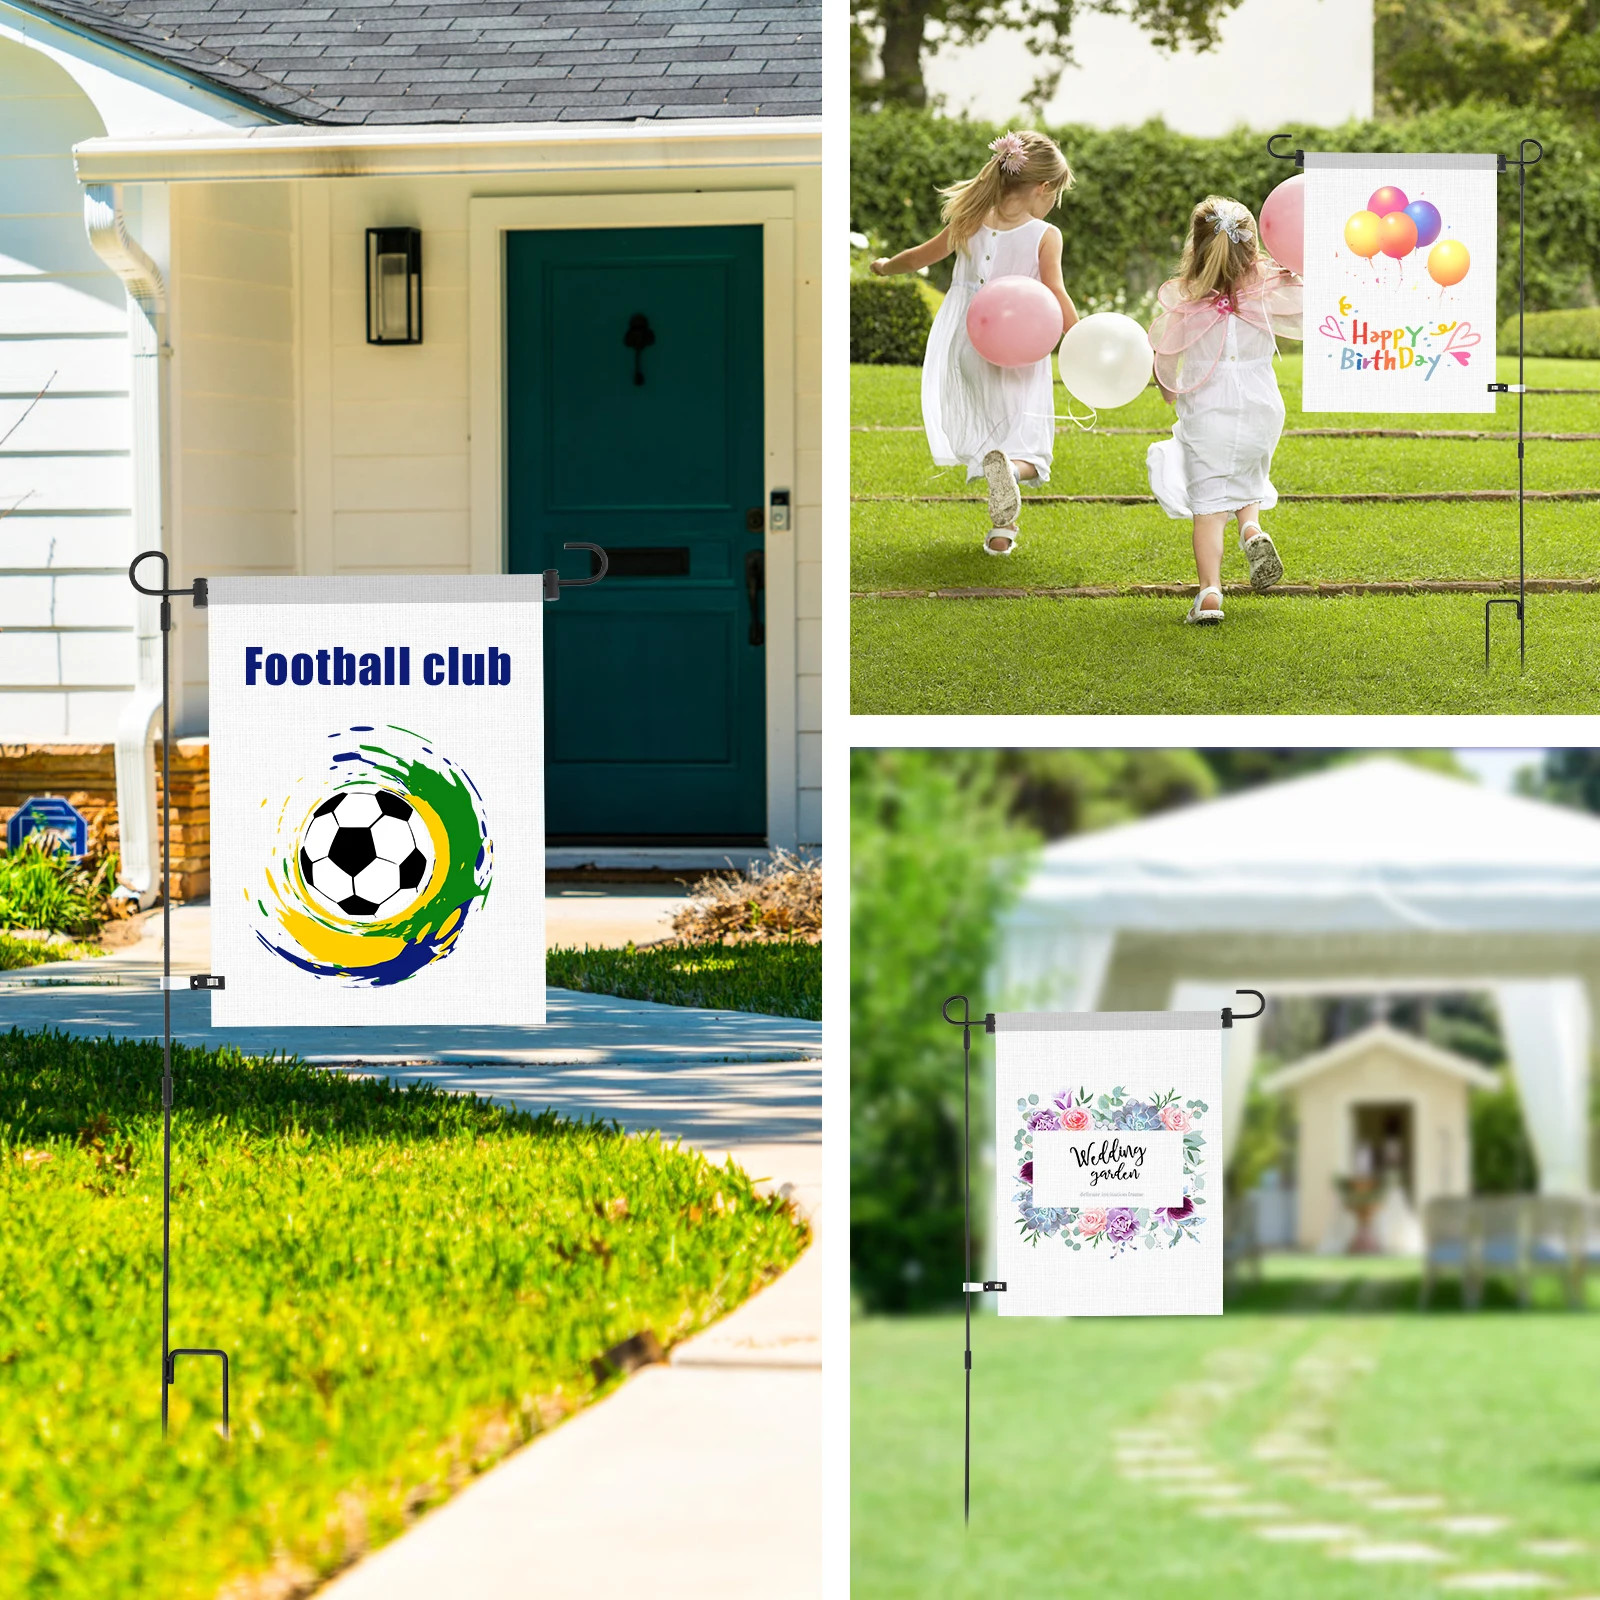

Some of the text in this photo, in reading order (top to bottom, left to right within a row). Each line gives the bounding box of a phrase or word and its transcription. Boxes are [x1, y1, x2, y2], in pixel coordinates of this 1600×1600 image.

[1340, 346, 1442, 381] BirthDay
[245, 646, 511, 686] Football club
[1069, 1138, 1147, 1168] Wedding
[1089, 1162, 1141, 1187] garden
